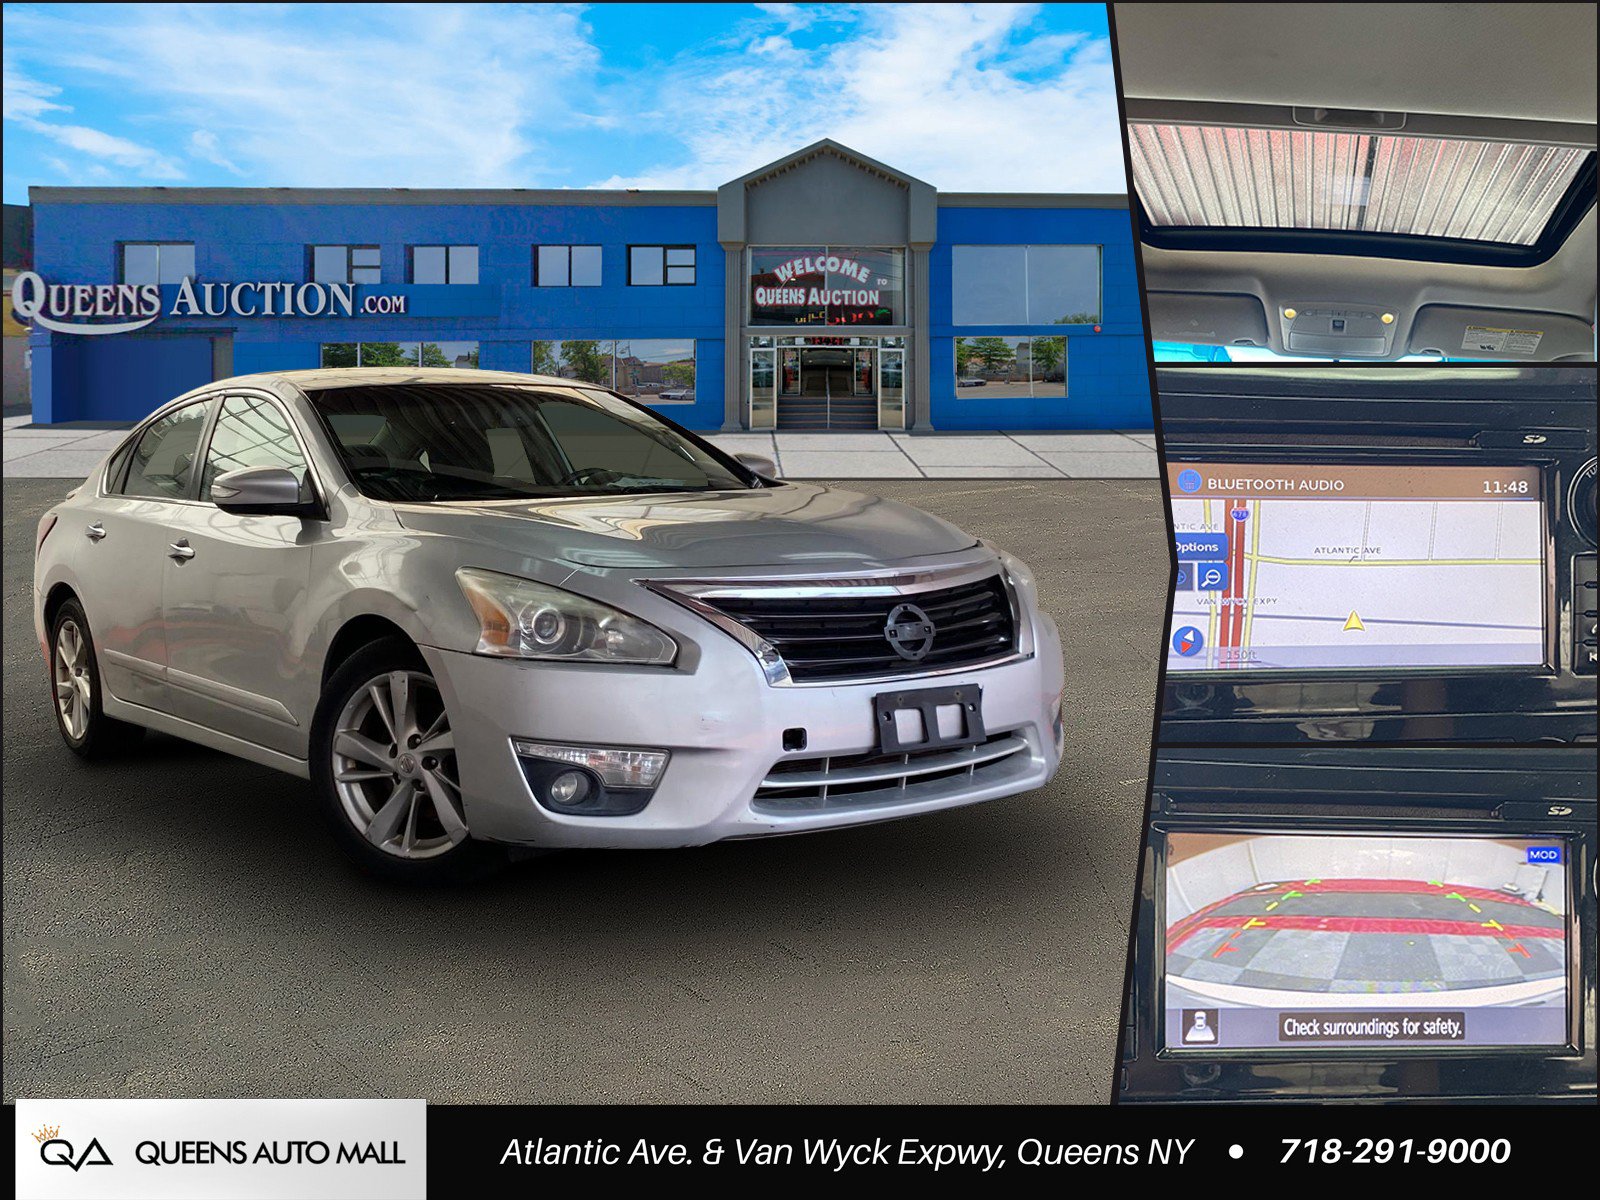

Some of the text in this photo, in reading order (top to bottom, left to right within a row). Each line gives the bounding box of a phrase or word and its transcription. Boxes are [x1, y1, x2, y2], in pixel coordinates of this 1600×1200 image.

[773, 256, 871, 284] WELCOME
[12, 271, 161, 335] QUEENS
[754, 287, 880, 306] QUEENS AUCTION
[1207, 478, 1345, 492] BLUETOOTH AUDIO
[1483, 480, 1529, 494] 11:48
[1199, 523, 1219, 531] AVE
[1253, 598, 1278, 606] EXPY
[1227, 650, 1258, 661] 150ft
[1529, 850, 1558, 860] MOD
[1284, 1017, 1463, 1038] Check surroundings for safety.
